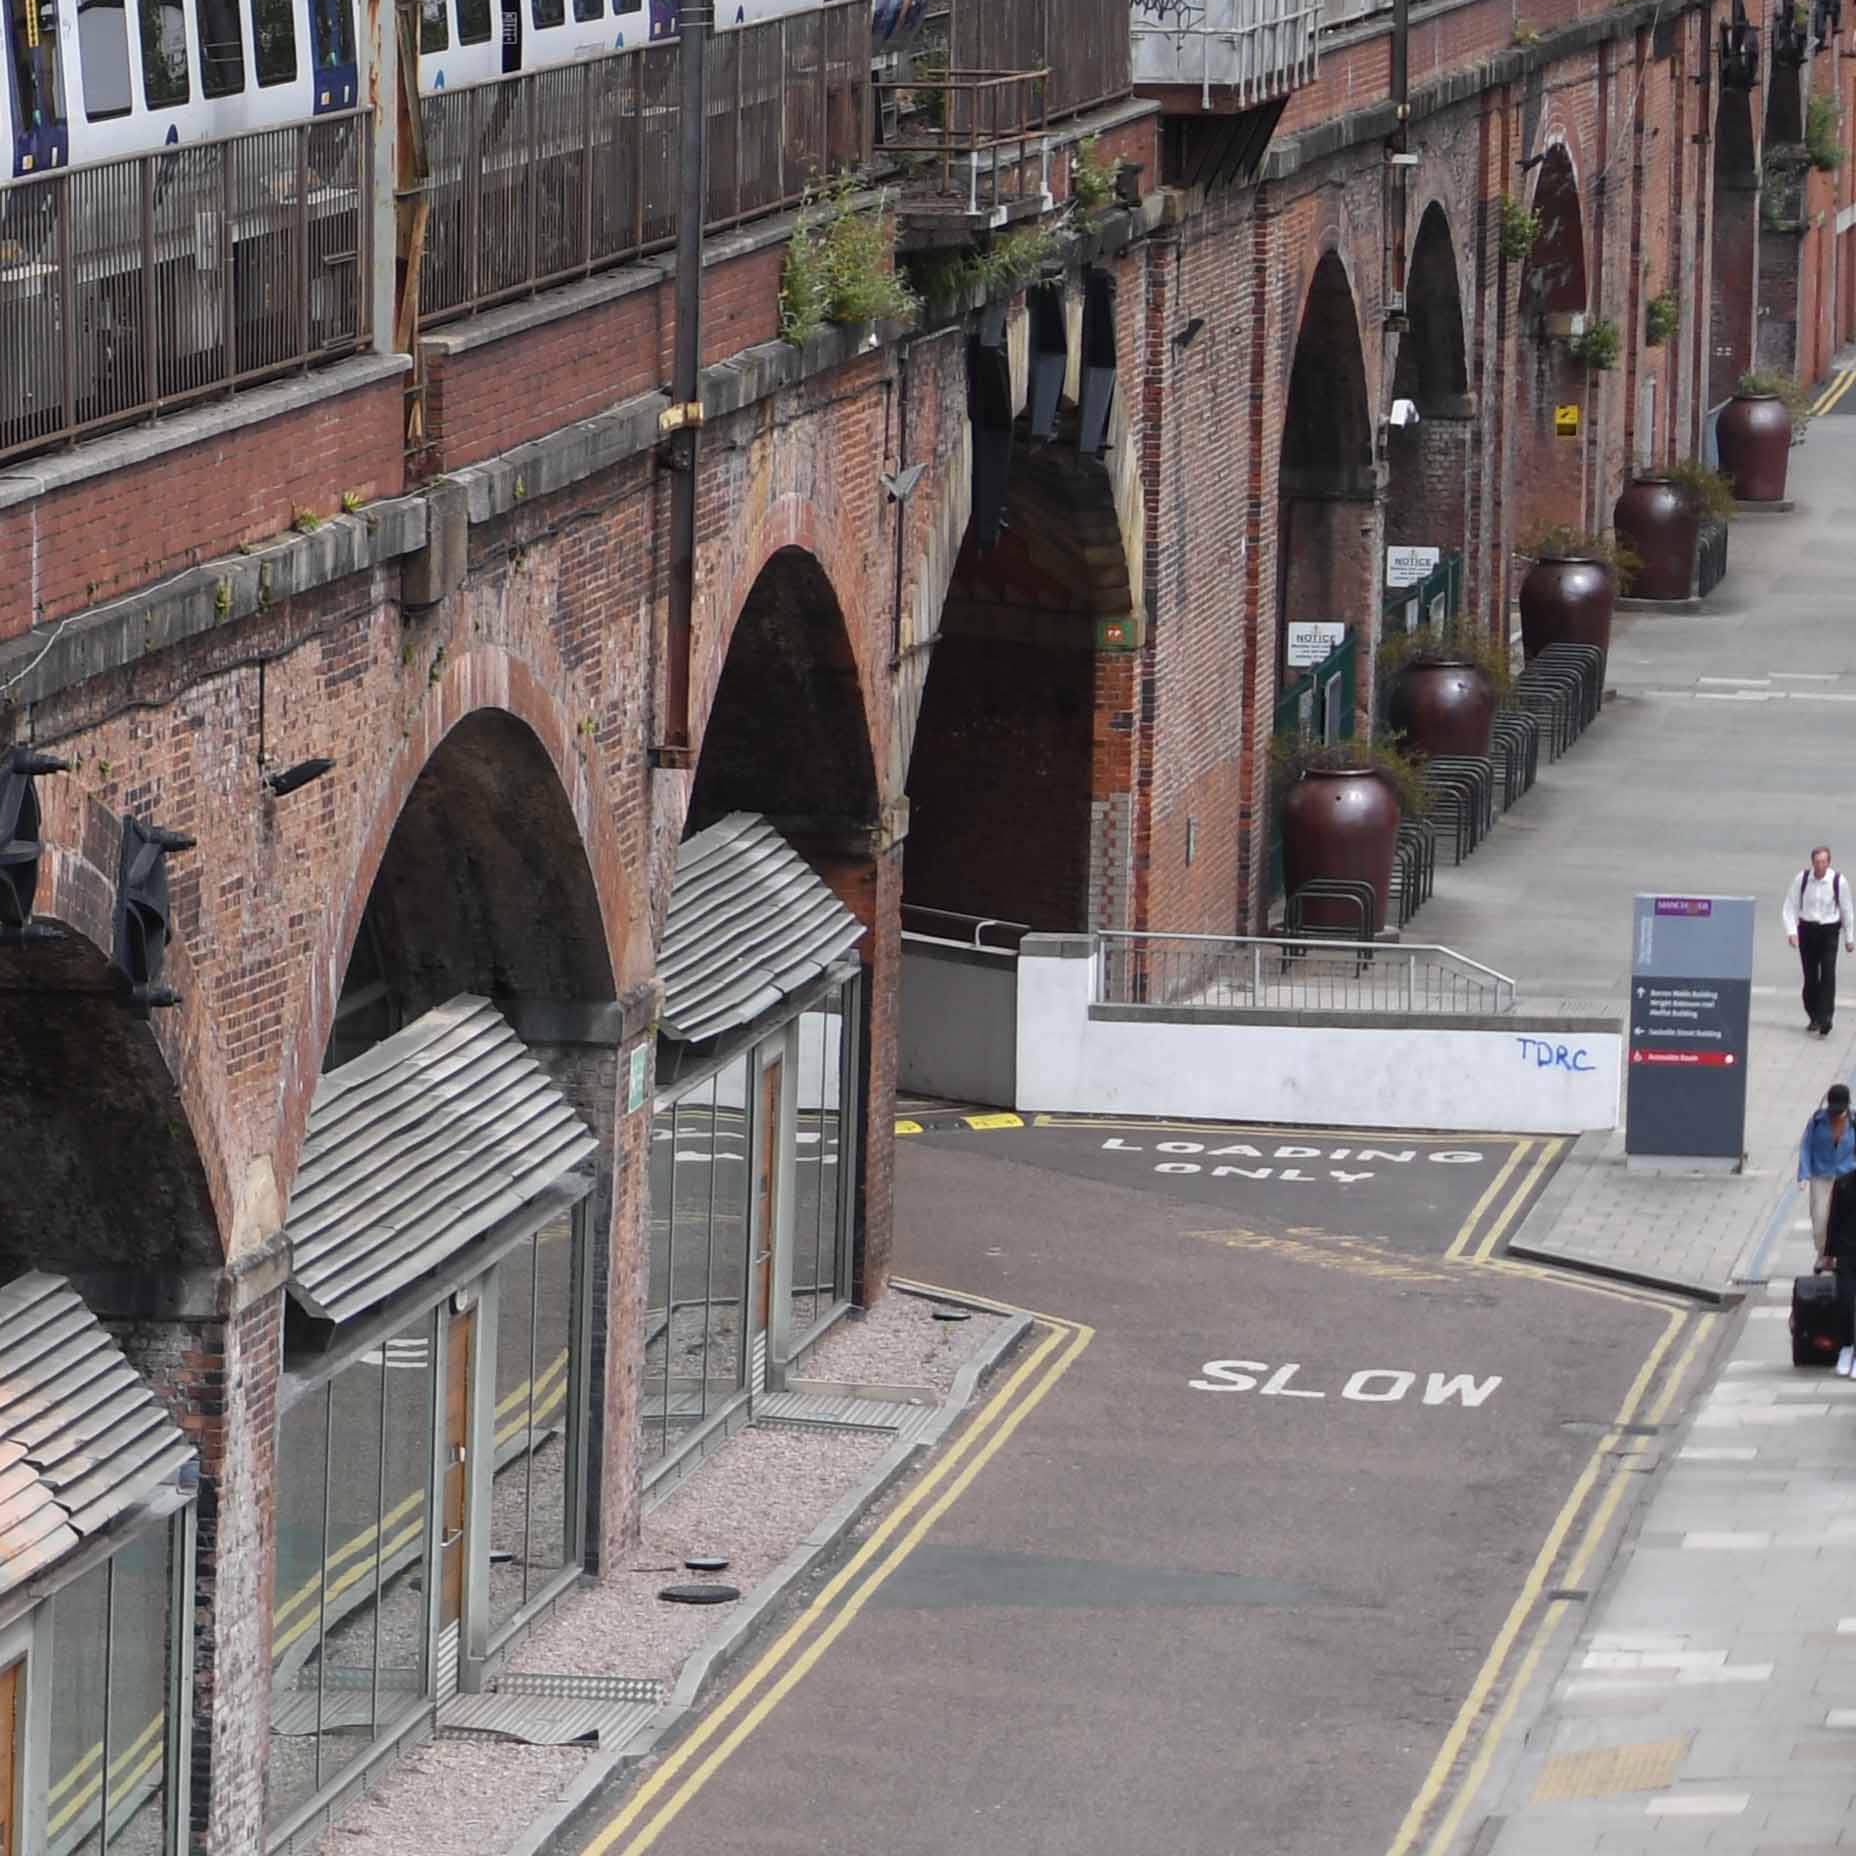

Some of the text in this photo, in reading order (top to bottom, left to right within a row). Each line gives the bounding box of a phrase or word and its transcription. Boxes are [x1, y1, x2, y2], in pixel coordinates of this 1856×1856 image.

[1100, 1137, 1484, 1164] LOADING
[1153, 1162, 1376, 1184] ONLY
[1188, 1359, 1503, 1408] SLOW
